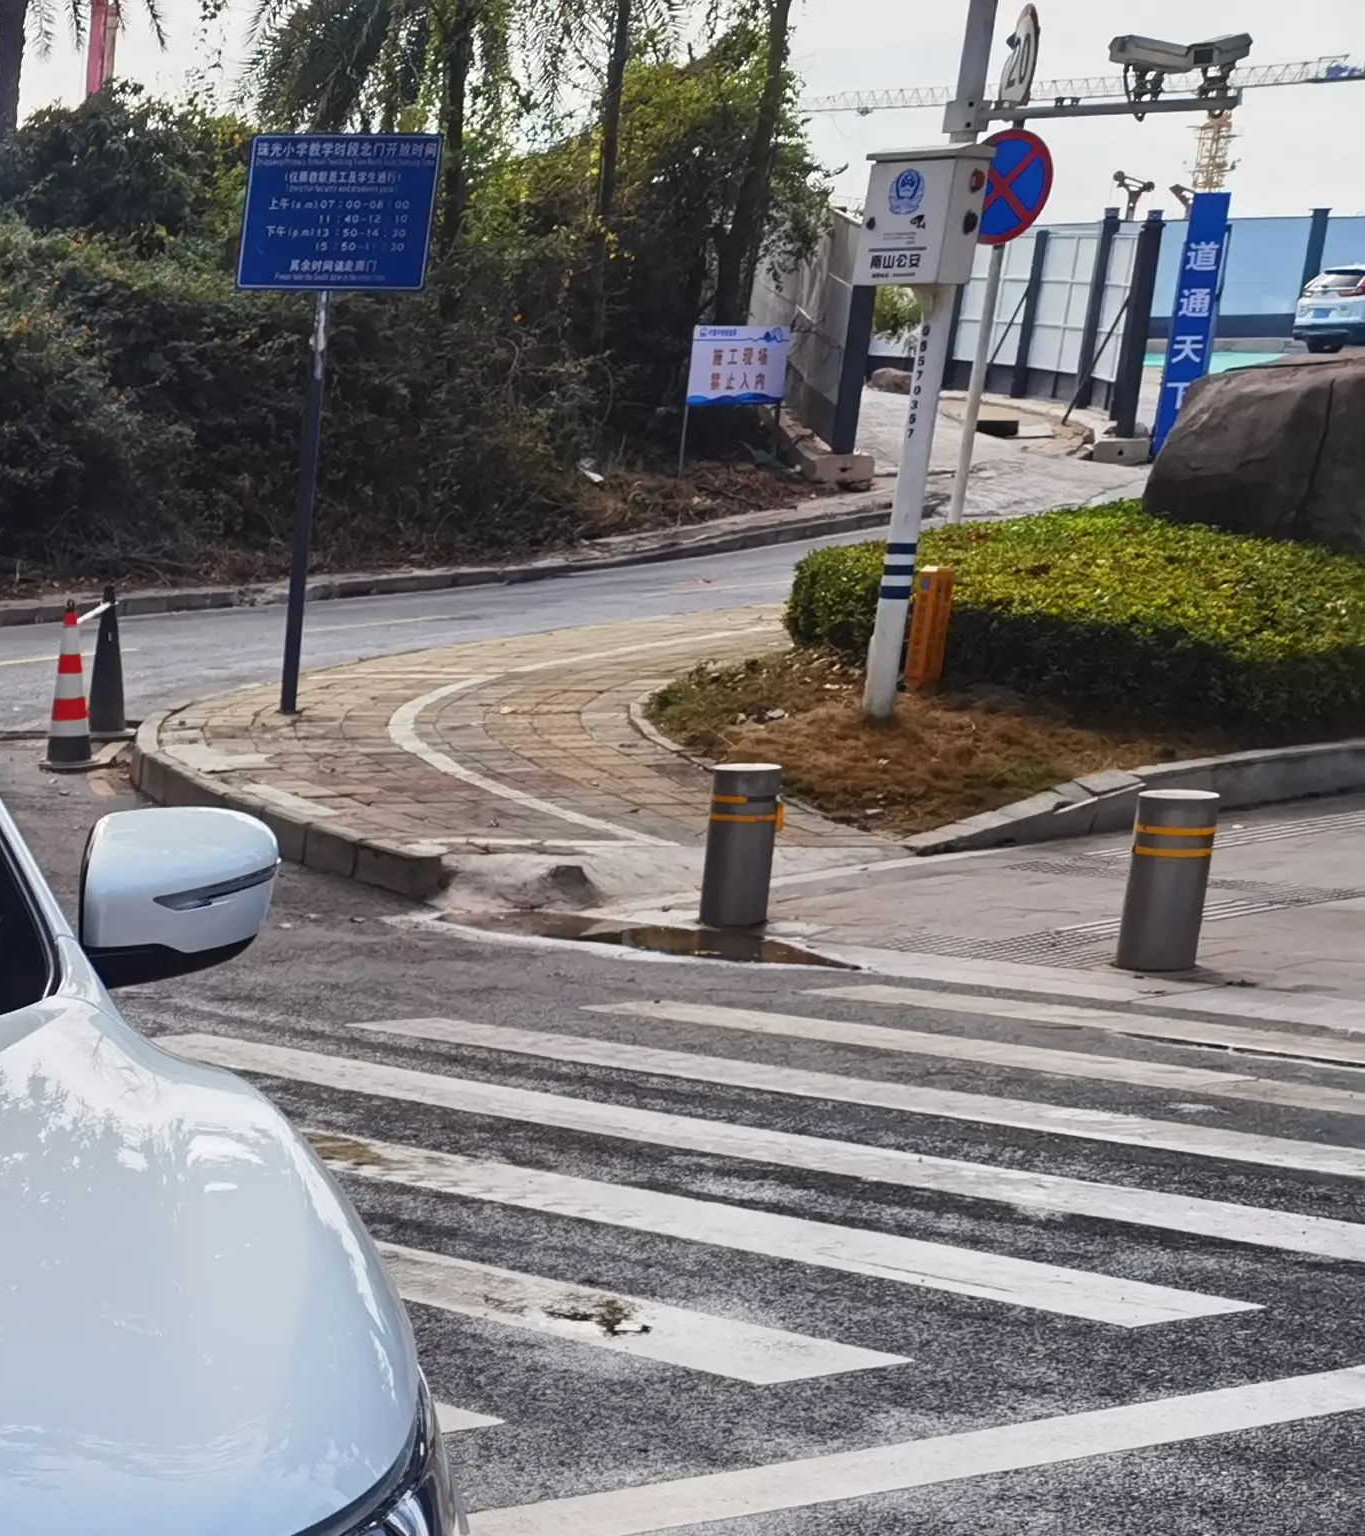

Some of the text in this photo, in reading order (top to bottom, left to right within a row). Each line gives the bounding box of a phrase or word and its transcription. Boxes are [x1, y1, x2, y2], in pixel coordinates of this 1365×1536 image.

[1005, 33, 1031, 90] 20
[870, 253, 921, 269] 南山公安
[710, 371, 767, 391] 禁止入内
